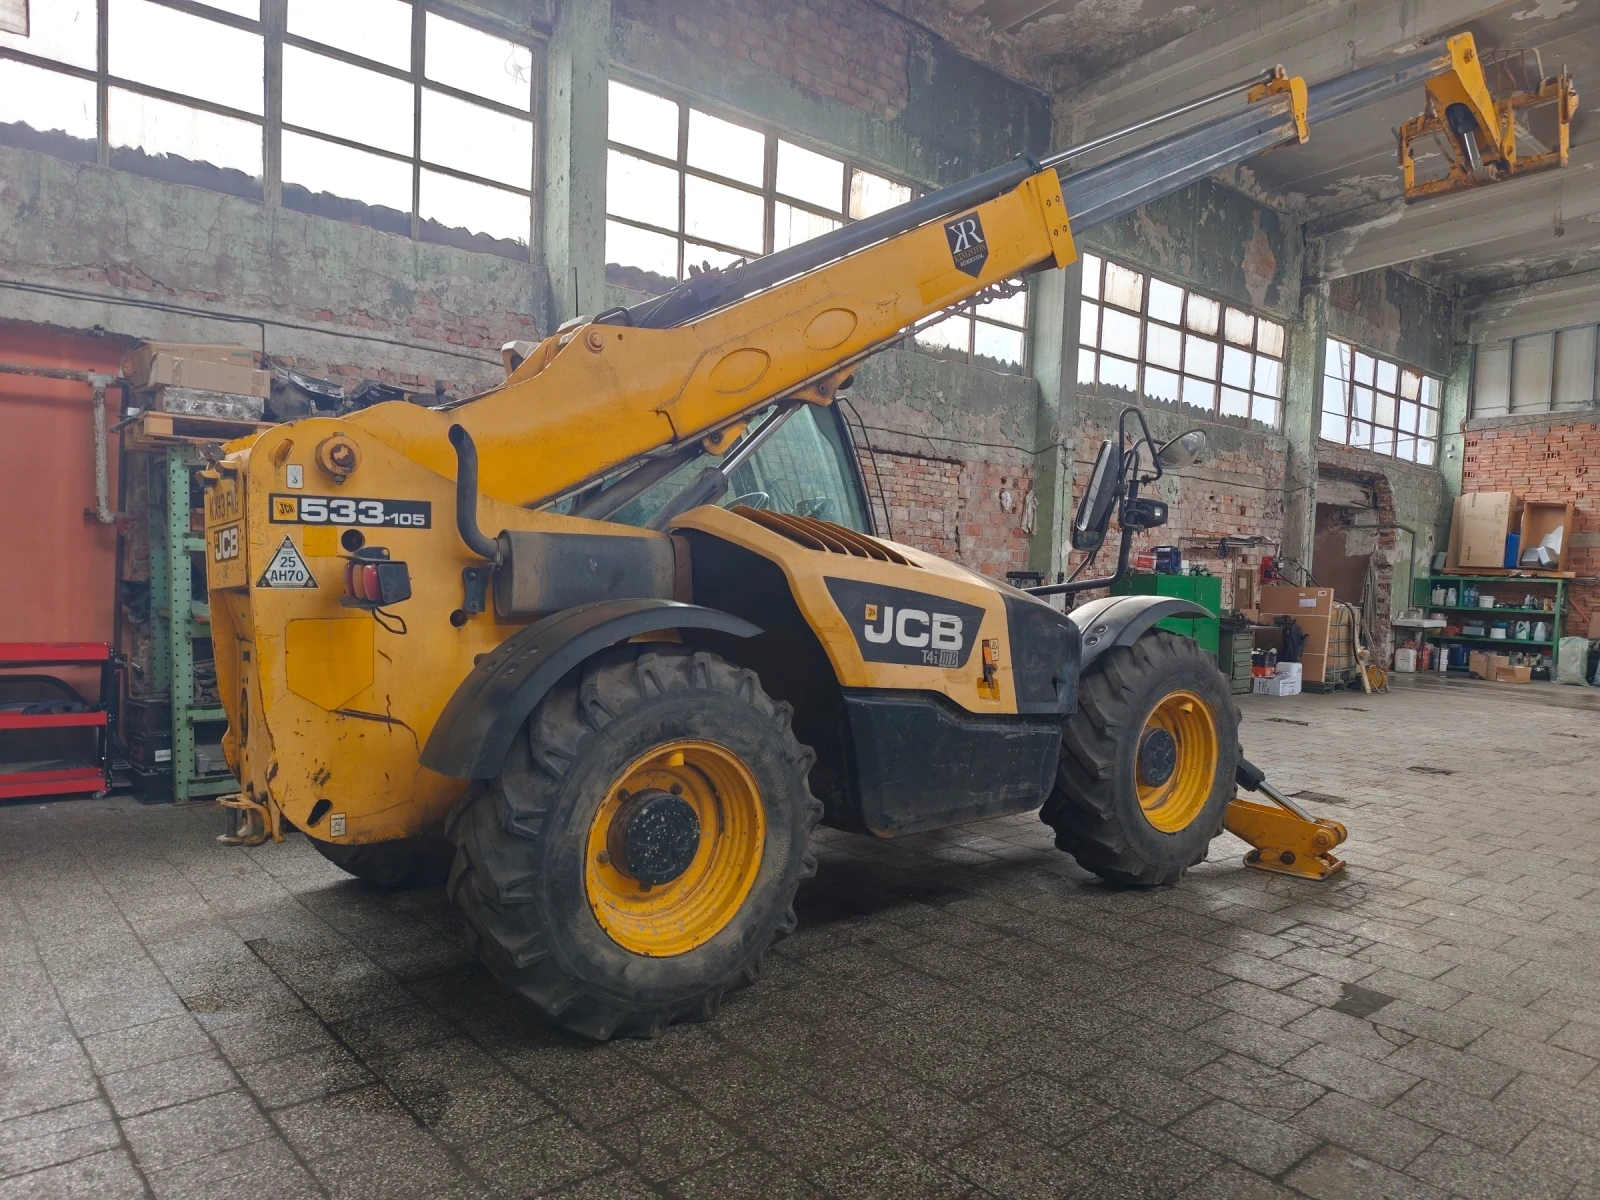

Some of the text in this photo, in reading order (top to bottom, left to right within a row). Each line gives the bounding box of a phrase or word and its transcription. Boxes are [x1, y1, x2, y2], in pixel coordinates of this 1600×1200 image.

[279, 498, 425, 526] JCB 533-105
[215, 527, 239, 560] JCB
[280, 556, 296, 568] 25
[271, 570, 304, 581] AH70
[864, 606, 964, 651] JCB
[921, 649, 938, 665] T4i
